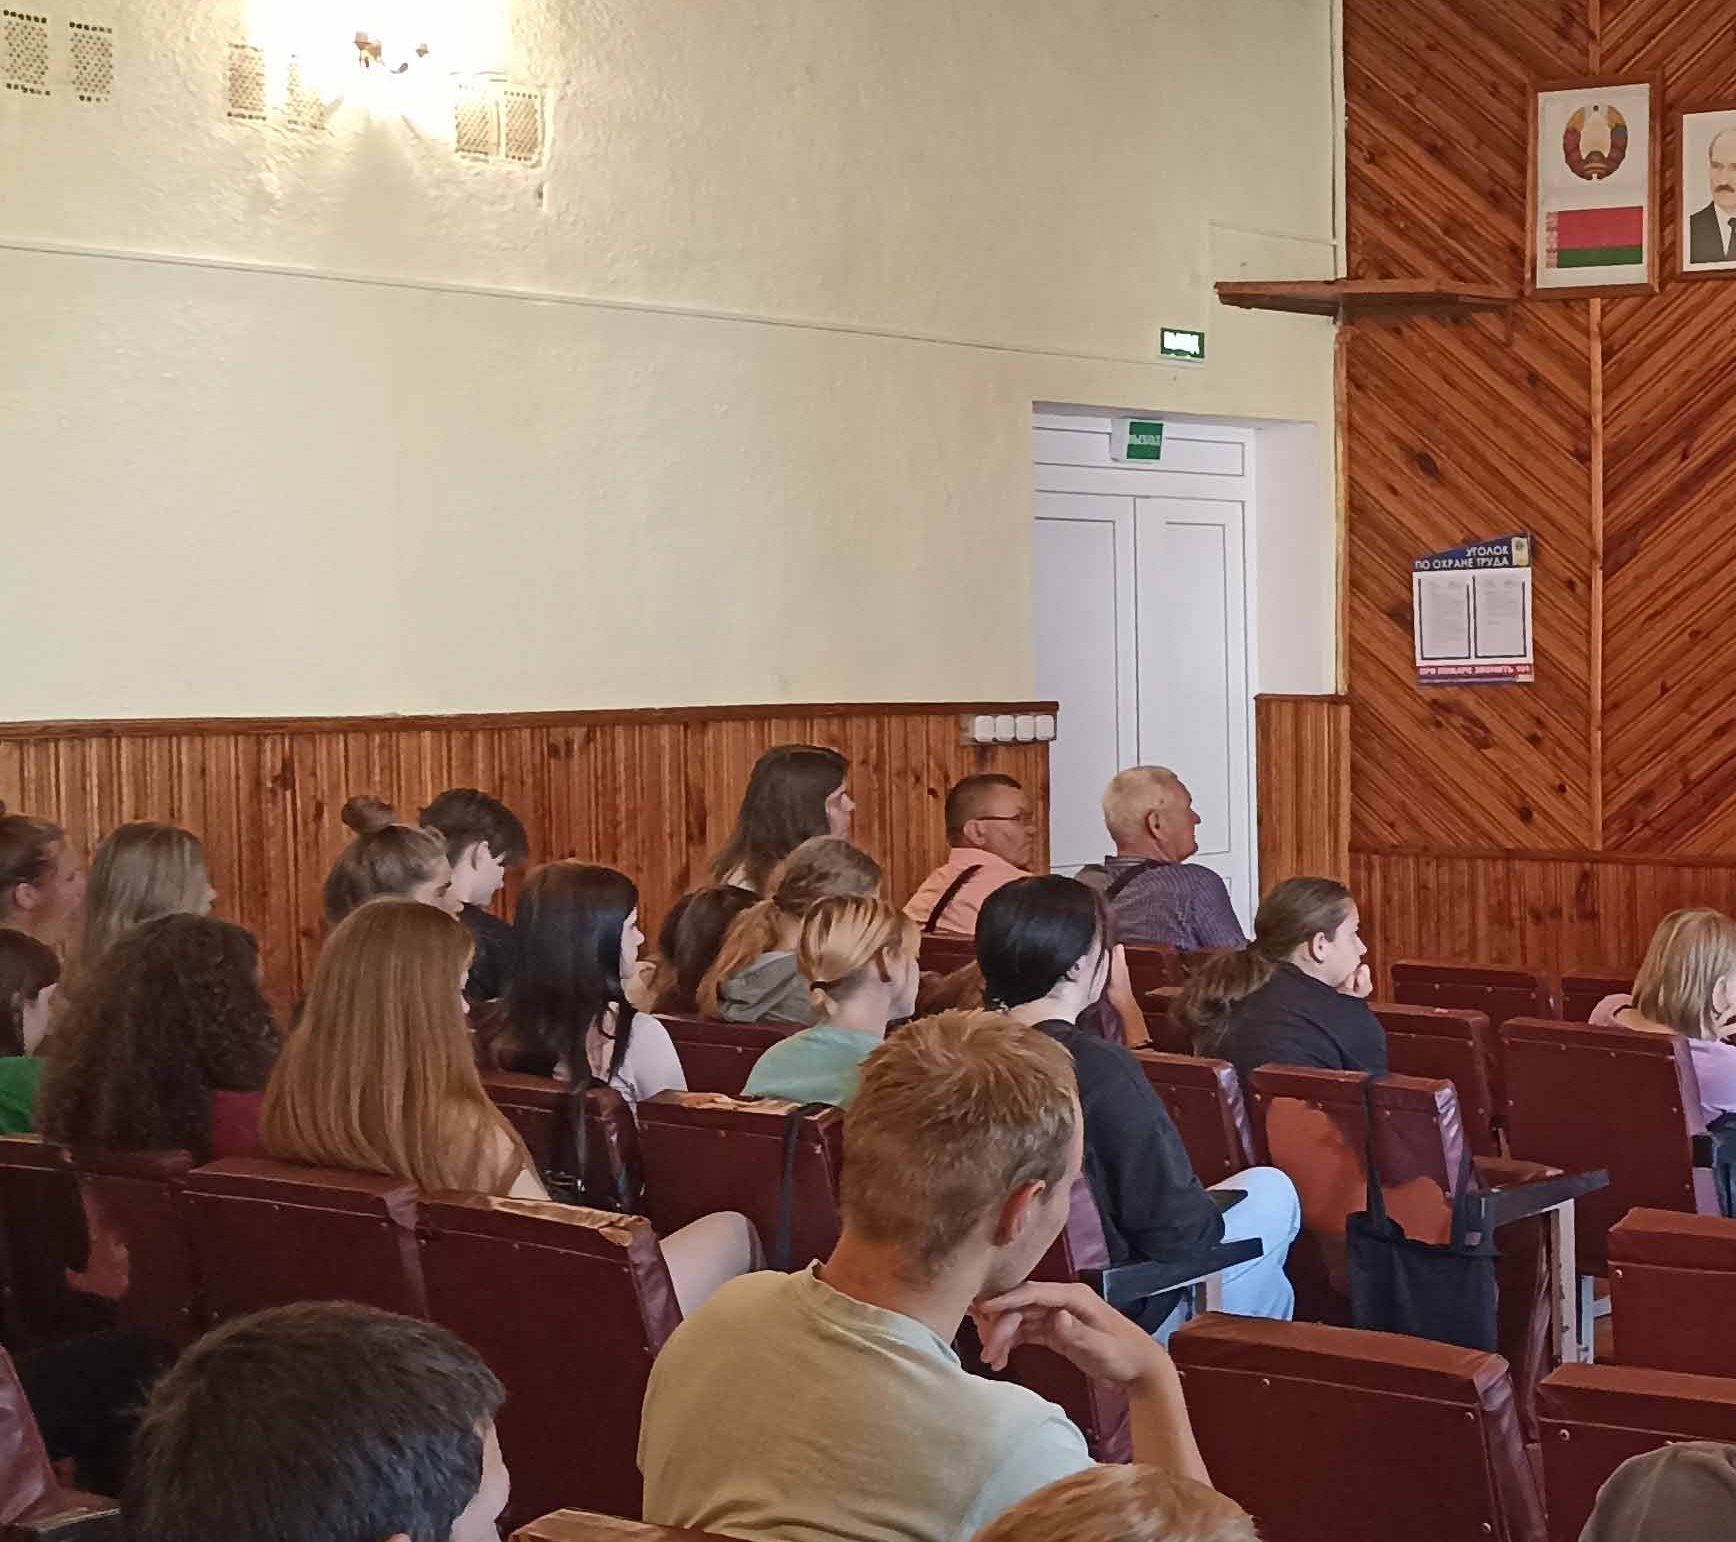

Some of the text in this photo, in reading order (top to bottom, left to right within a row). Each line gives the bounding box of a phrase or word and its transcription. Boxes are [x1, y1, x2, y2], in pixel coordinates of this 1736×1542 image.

[1465, 545, 1509, 557] УГОЛОК
[1415, 556, 1510, 570] ПО ОХРАНЕ ТРУДА
